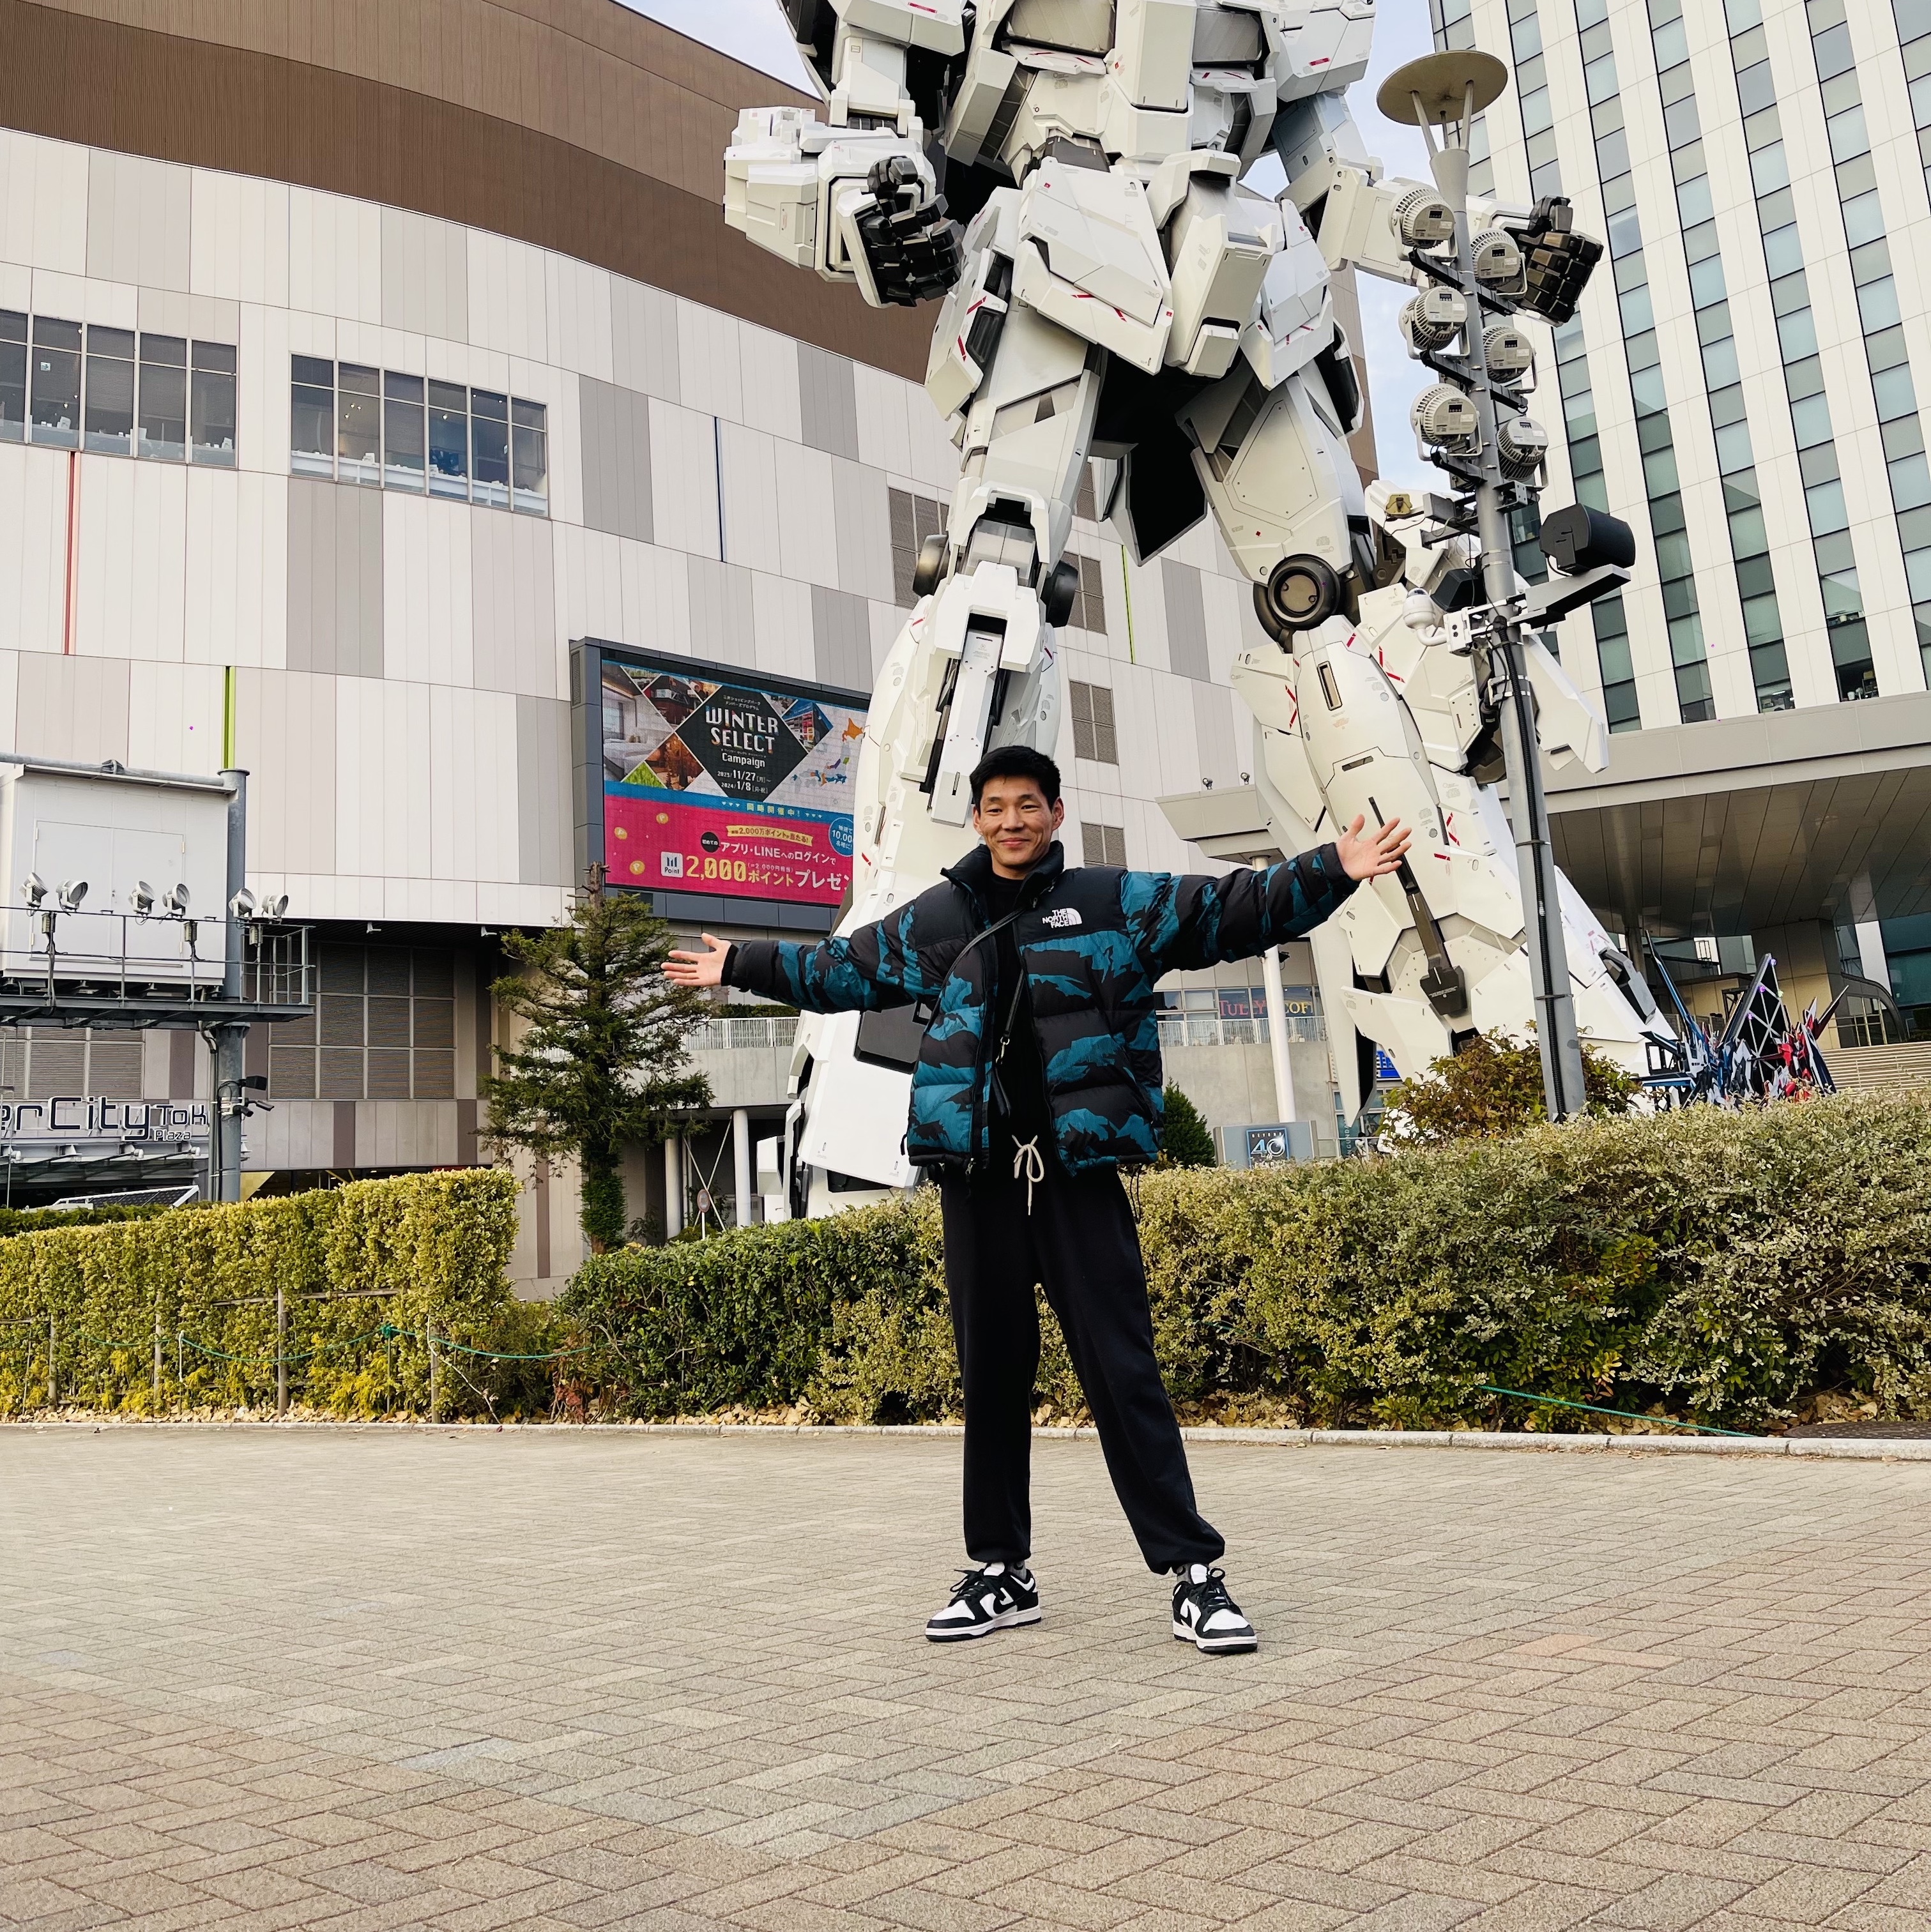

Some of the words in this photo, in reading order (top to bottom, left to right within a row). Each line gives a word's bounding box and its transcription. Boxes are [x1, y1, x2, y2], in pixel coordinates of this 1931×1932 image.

[705, 705, 779, 736] WINTER
[711, 727, 775, 754] SELECT
[722, 752, 765, 769] Campaign
[1042, 913, 1068, 924] NORTH
[1051, 908, 1067, 917] THE
[1050, 920, 1069, 929] FACE
[153, 1104, 210, 1126] Tok
[153, 1129, 192, 1141] Plaza
